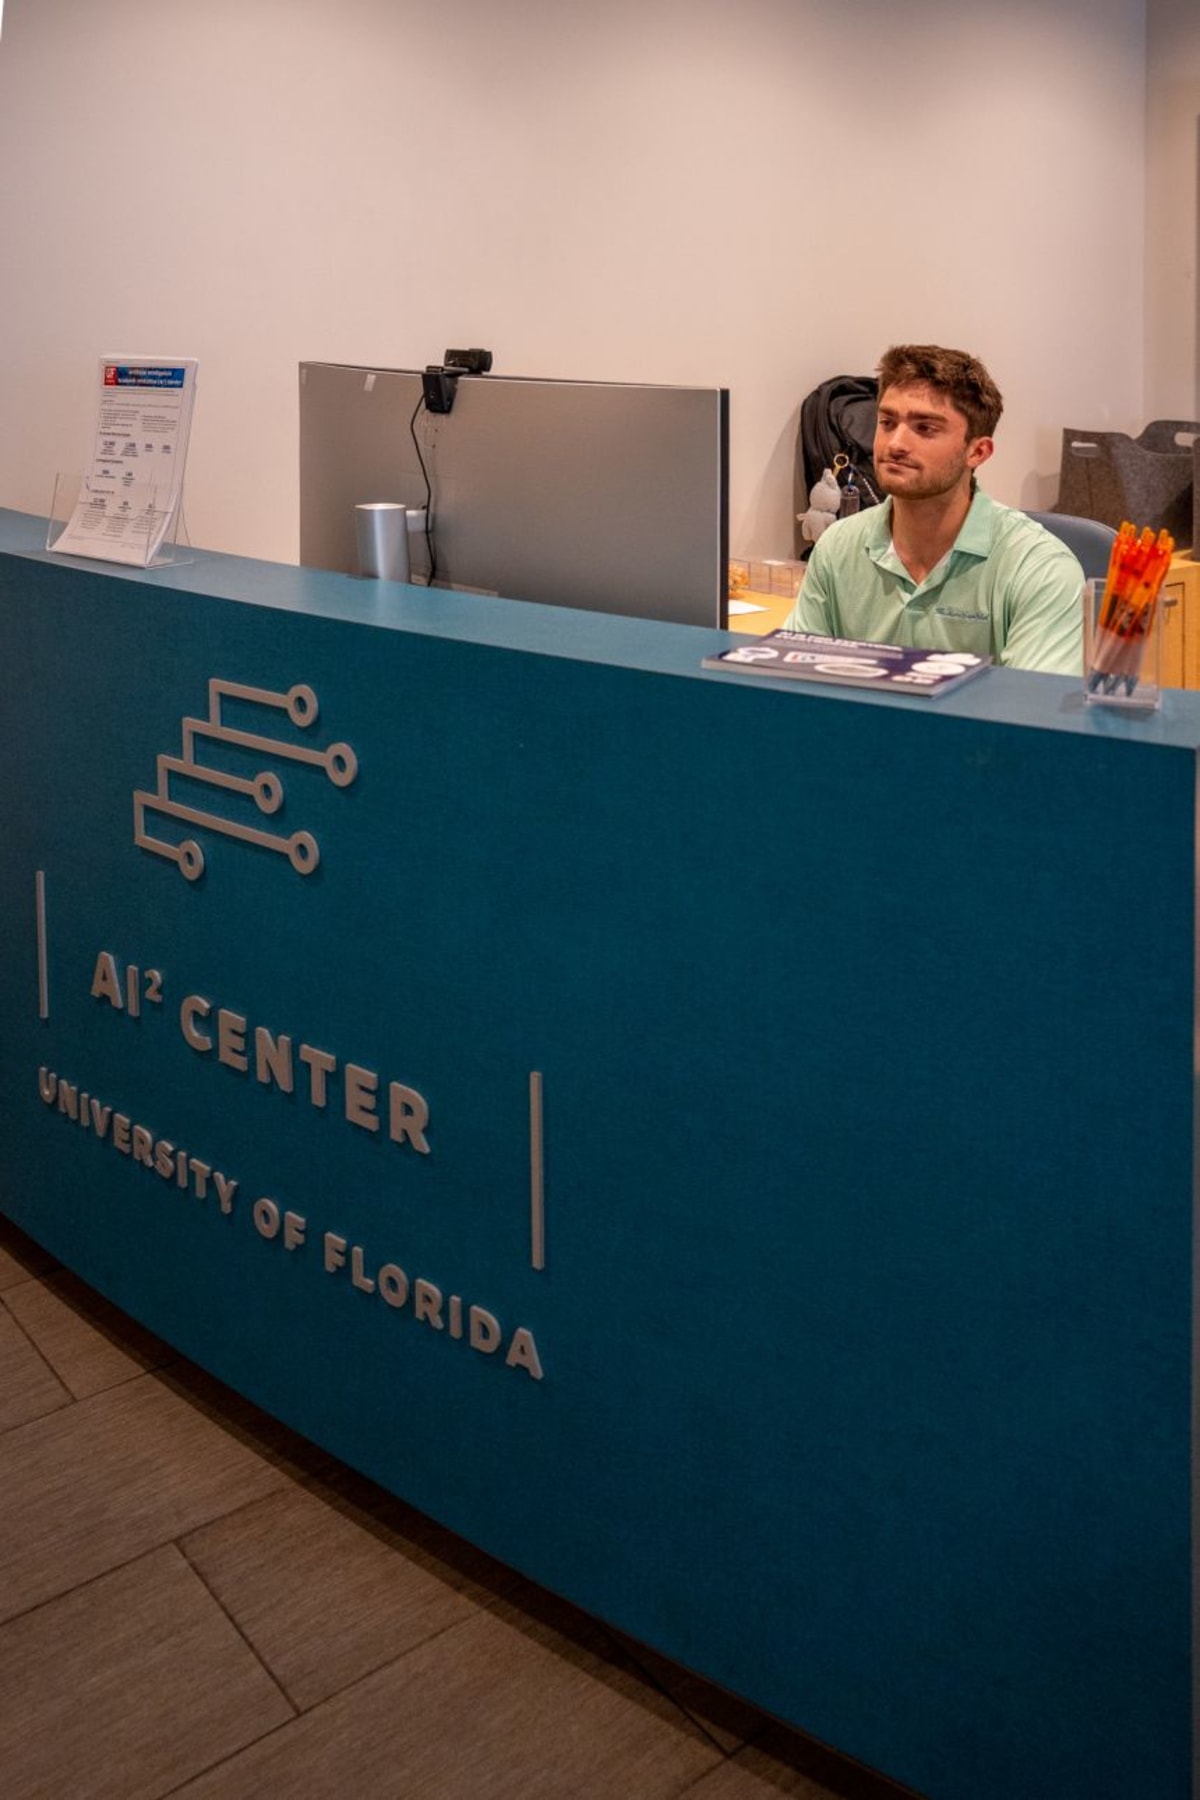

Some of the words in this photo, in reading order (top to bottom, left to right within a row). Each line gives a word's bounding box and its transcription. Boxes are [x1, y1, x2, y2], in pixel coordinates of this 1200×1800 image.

[180, 994, 431, 1154] CENTER
[38, 1067, 238, 1214] UNIVERSITY
[253, 1197, 306, 1250] OF
[324, 1231, 545, 1379] FLORIDA
